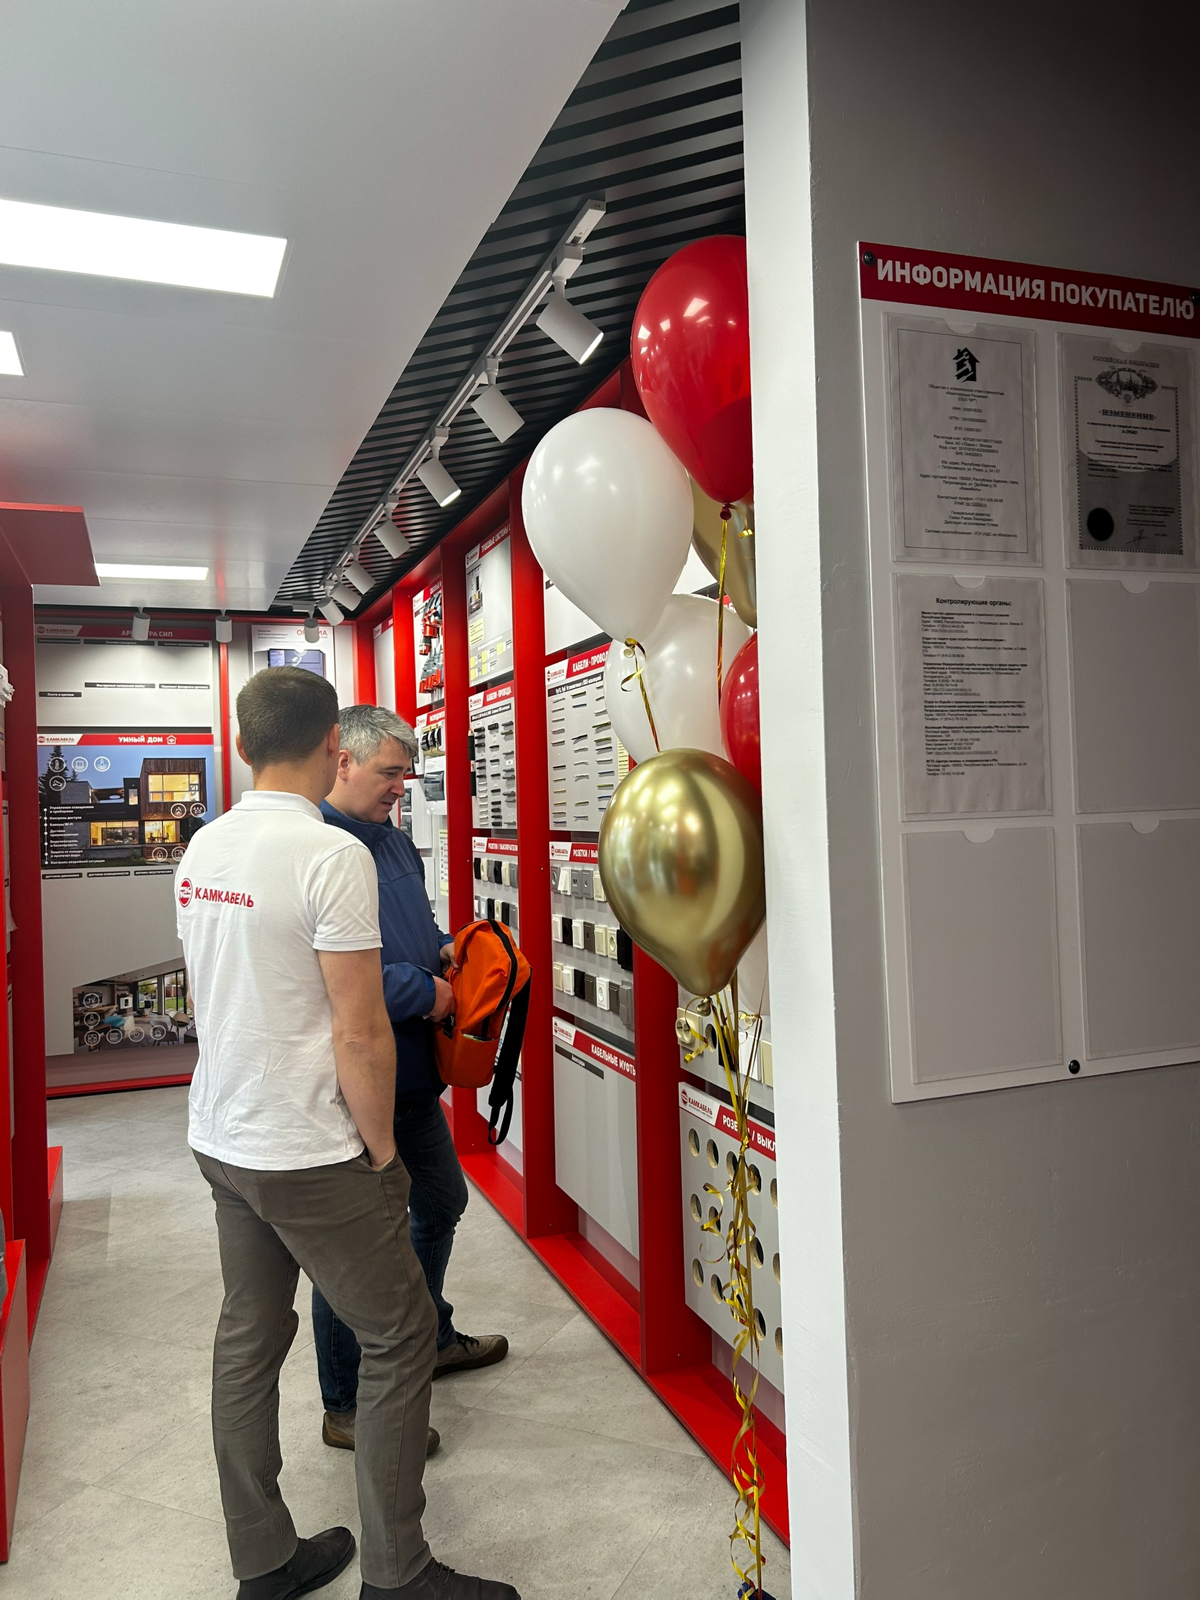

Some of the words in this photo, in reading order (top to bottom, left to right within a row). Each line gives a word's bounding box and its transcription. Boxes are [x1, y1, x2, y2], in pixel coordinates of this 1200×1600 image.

[877, 258, 1045, 301] ИНФОРМАЦИЯ
[1050, 281, 1195, 320] ПОКУПАТЕЛЮ
[936, 597, 988, 607] Контролирующие
[118, 735, 145, 743] УМНЫЙ
[147, 736, 163, 744] ДОМ
[195, 887, 254, 908] КАМКАБЕЛЬ
[591, 1043, 618, 1067] КАБЕЛЬНЫЕ
[688, 1097, 713, 1116] КАМКАБЕЛЬ
